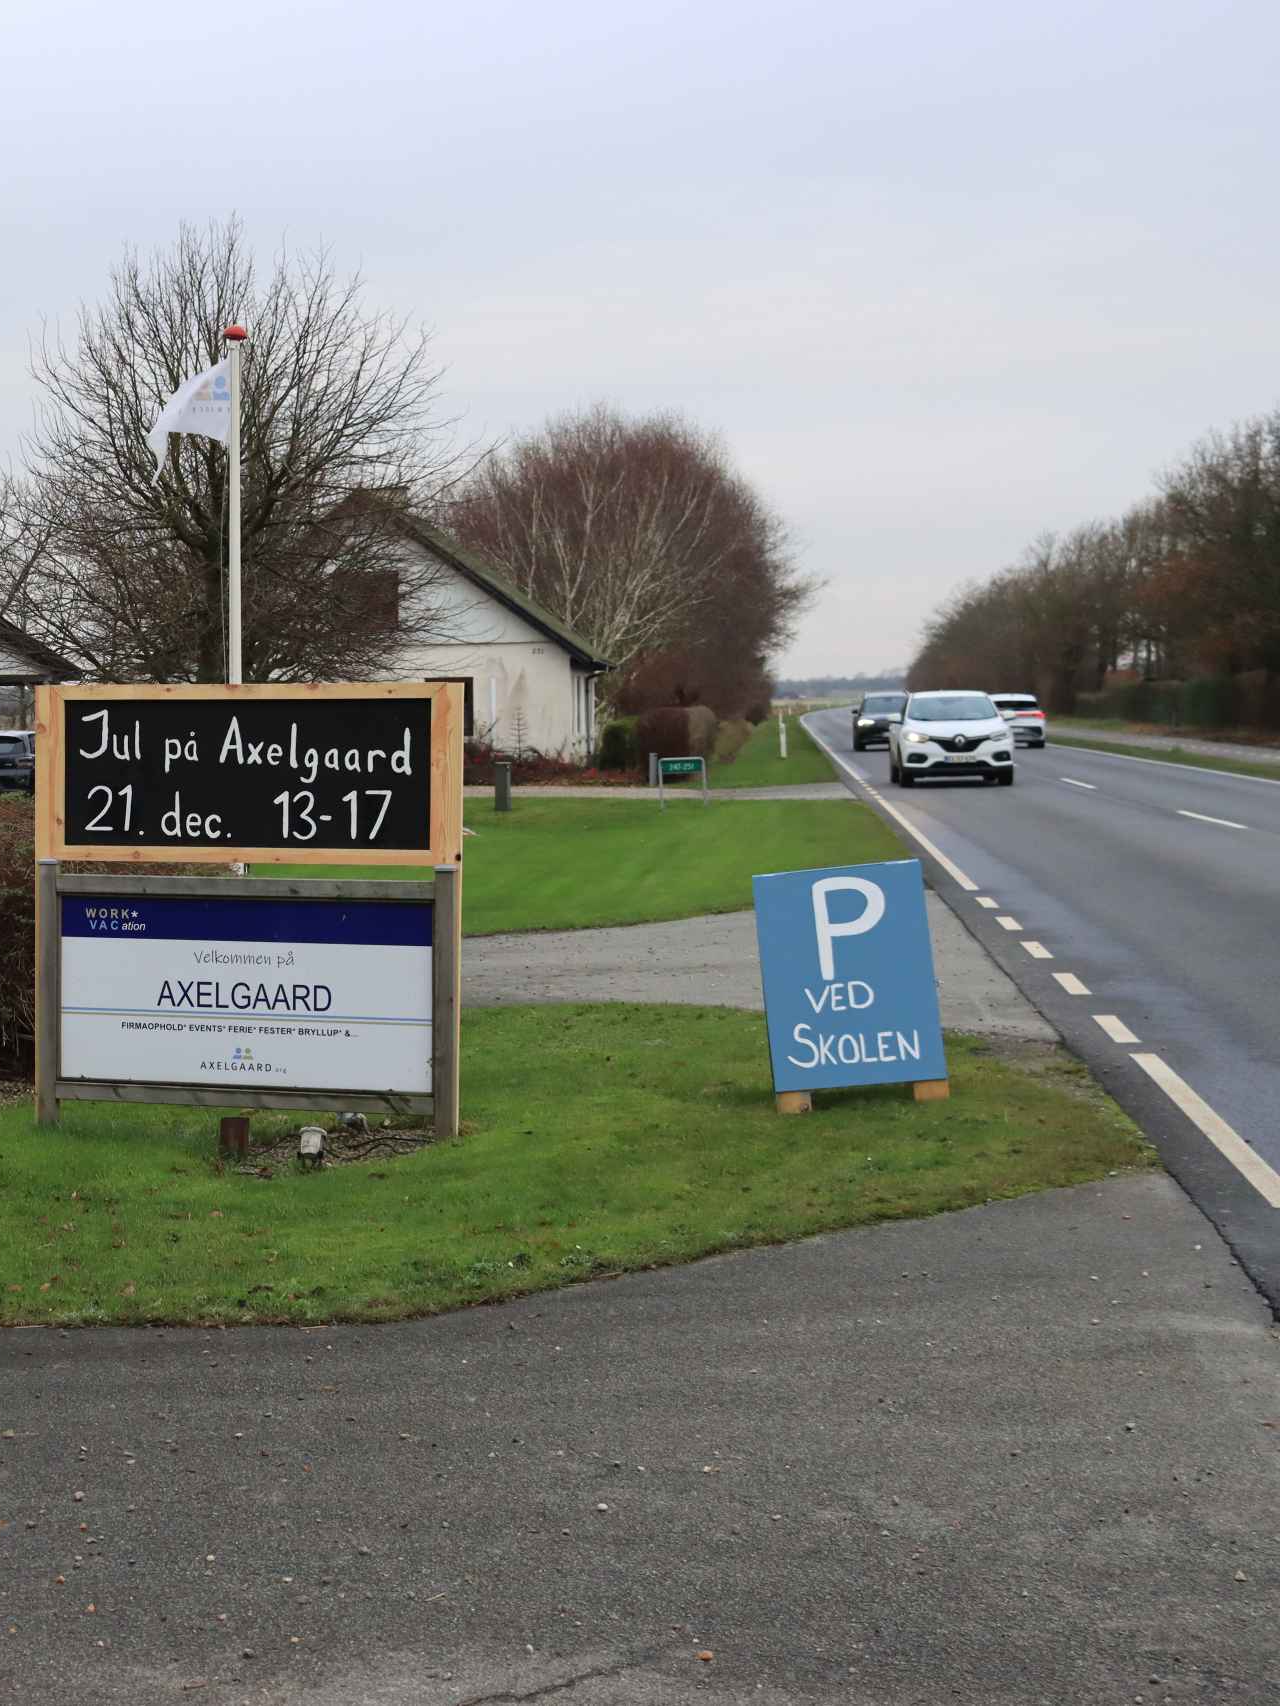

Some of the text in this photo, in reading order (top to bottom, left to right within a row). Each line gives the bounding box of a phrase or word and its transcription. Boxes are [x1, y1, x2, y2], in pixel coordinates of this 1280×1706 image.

[79, 709, 412, 783] Jul på Axelgaard
[84, 784, 393, 840] 21. dec. 13-17
[812, 876, 885, 981] P
[193, 949, 295, 968] Velkommen på
[157, 980, 332, 1012] AXELGAARD
[804, 980, 875, 1014] VED
[787, 1023, 920, 1068] SKOLEN
[200, 1061, 272, 1072] AXELGAARD
